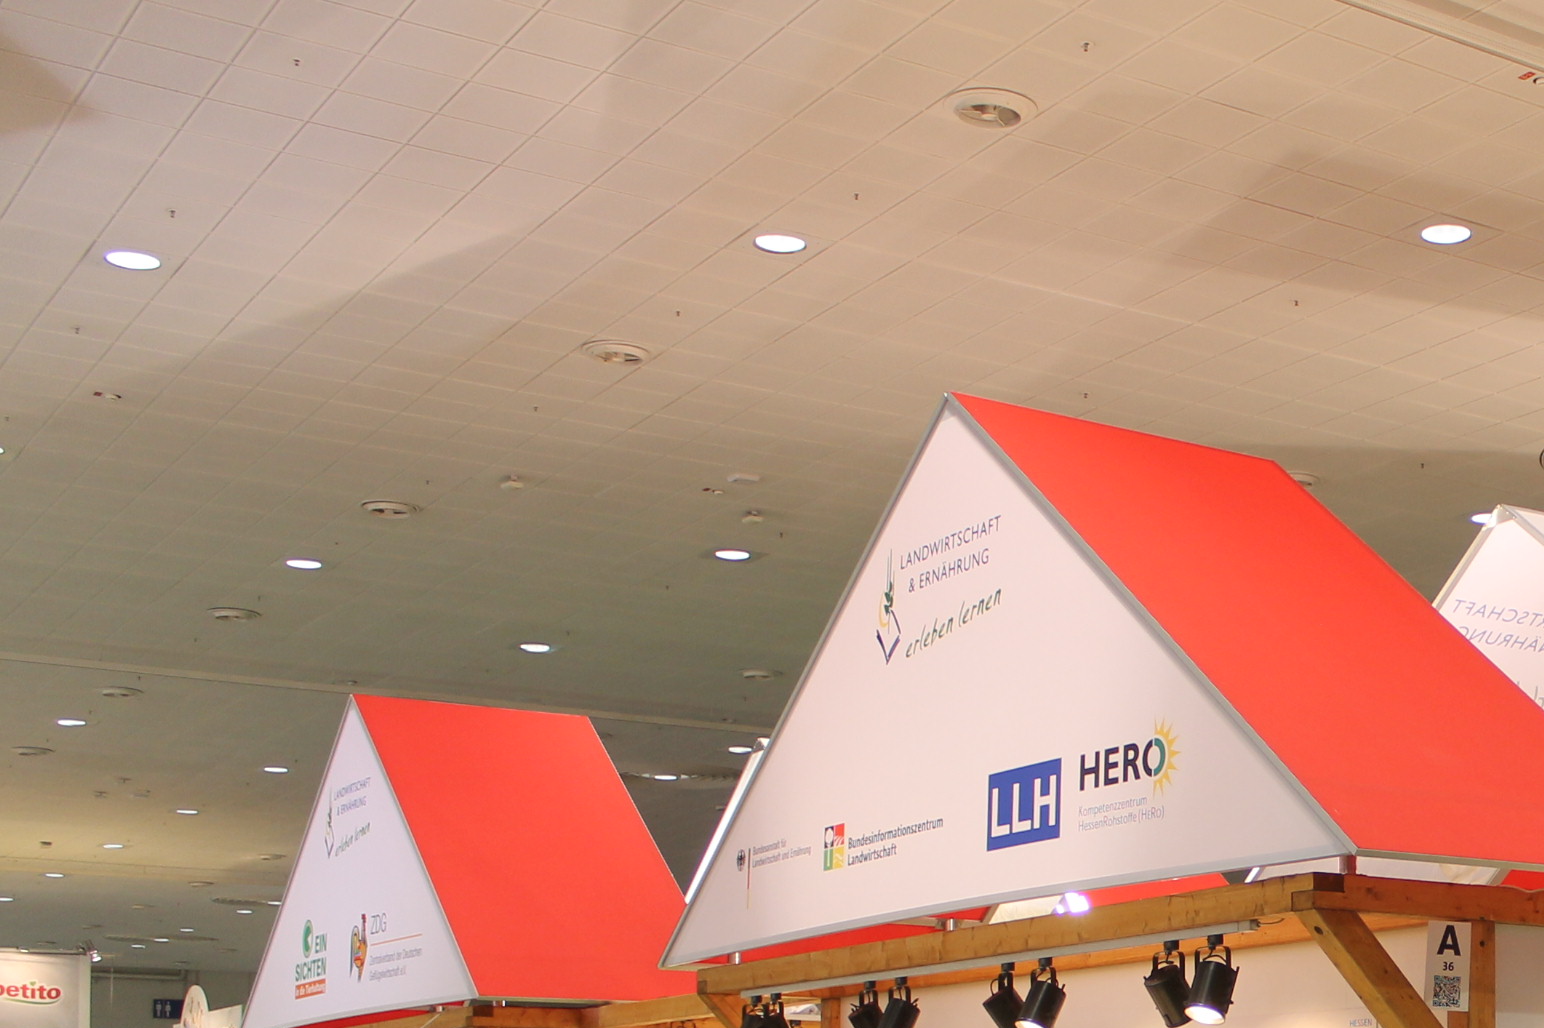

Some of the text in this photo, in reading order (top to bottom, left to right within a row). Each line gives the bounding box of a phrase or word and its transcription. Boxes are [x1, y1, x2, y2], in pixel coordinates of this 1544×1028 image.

[900, 515, 1001, 570] LANDWIRTSCHAFT
[908, 548, 990, 593] & ERNÄHRUNG
[905, 588, 1001, 659] erleben lernen
[1080, 737, 1166, 791] HERO
[991, 774, 1057, 838] LLH
[1078, 797, 1148, 817] Kompetenzzentrum
[848, 818, 944, 850] Bundesinformationszentrum
[1078, 812, 1137, 832] HessenRohstoffe
[848, 844, 898, 867] Landwirtschaft
[370, 913, 387, 935] ZDG
[315, 933, 327, 954] EIN
[1437, 925, 1461, 956] A
[295, 957, 326, 982] SICHTEN
[1443, 962, 1454, 971] 36
[1350, 1019, 1372, 1027] HESSEN
